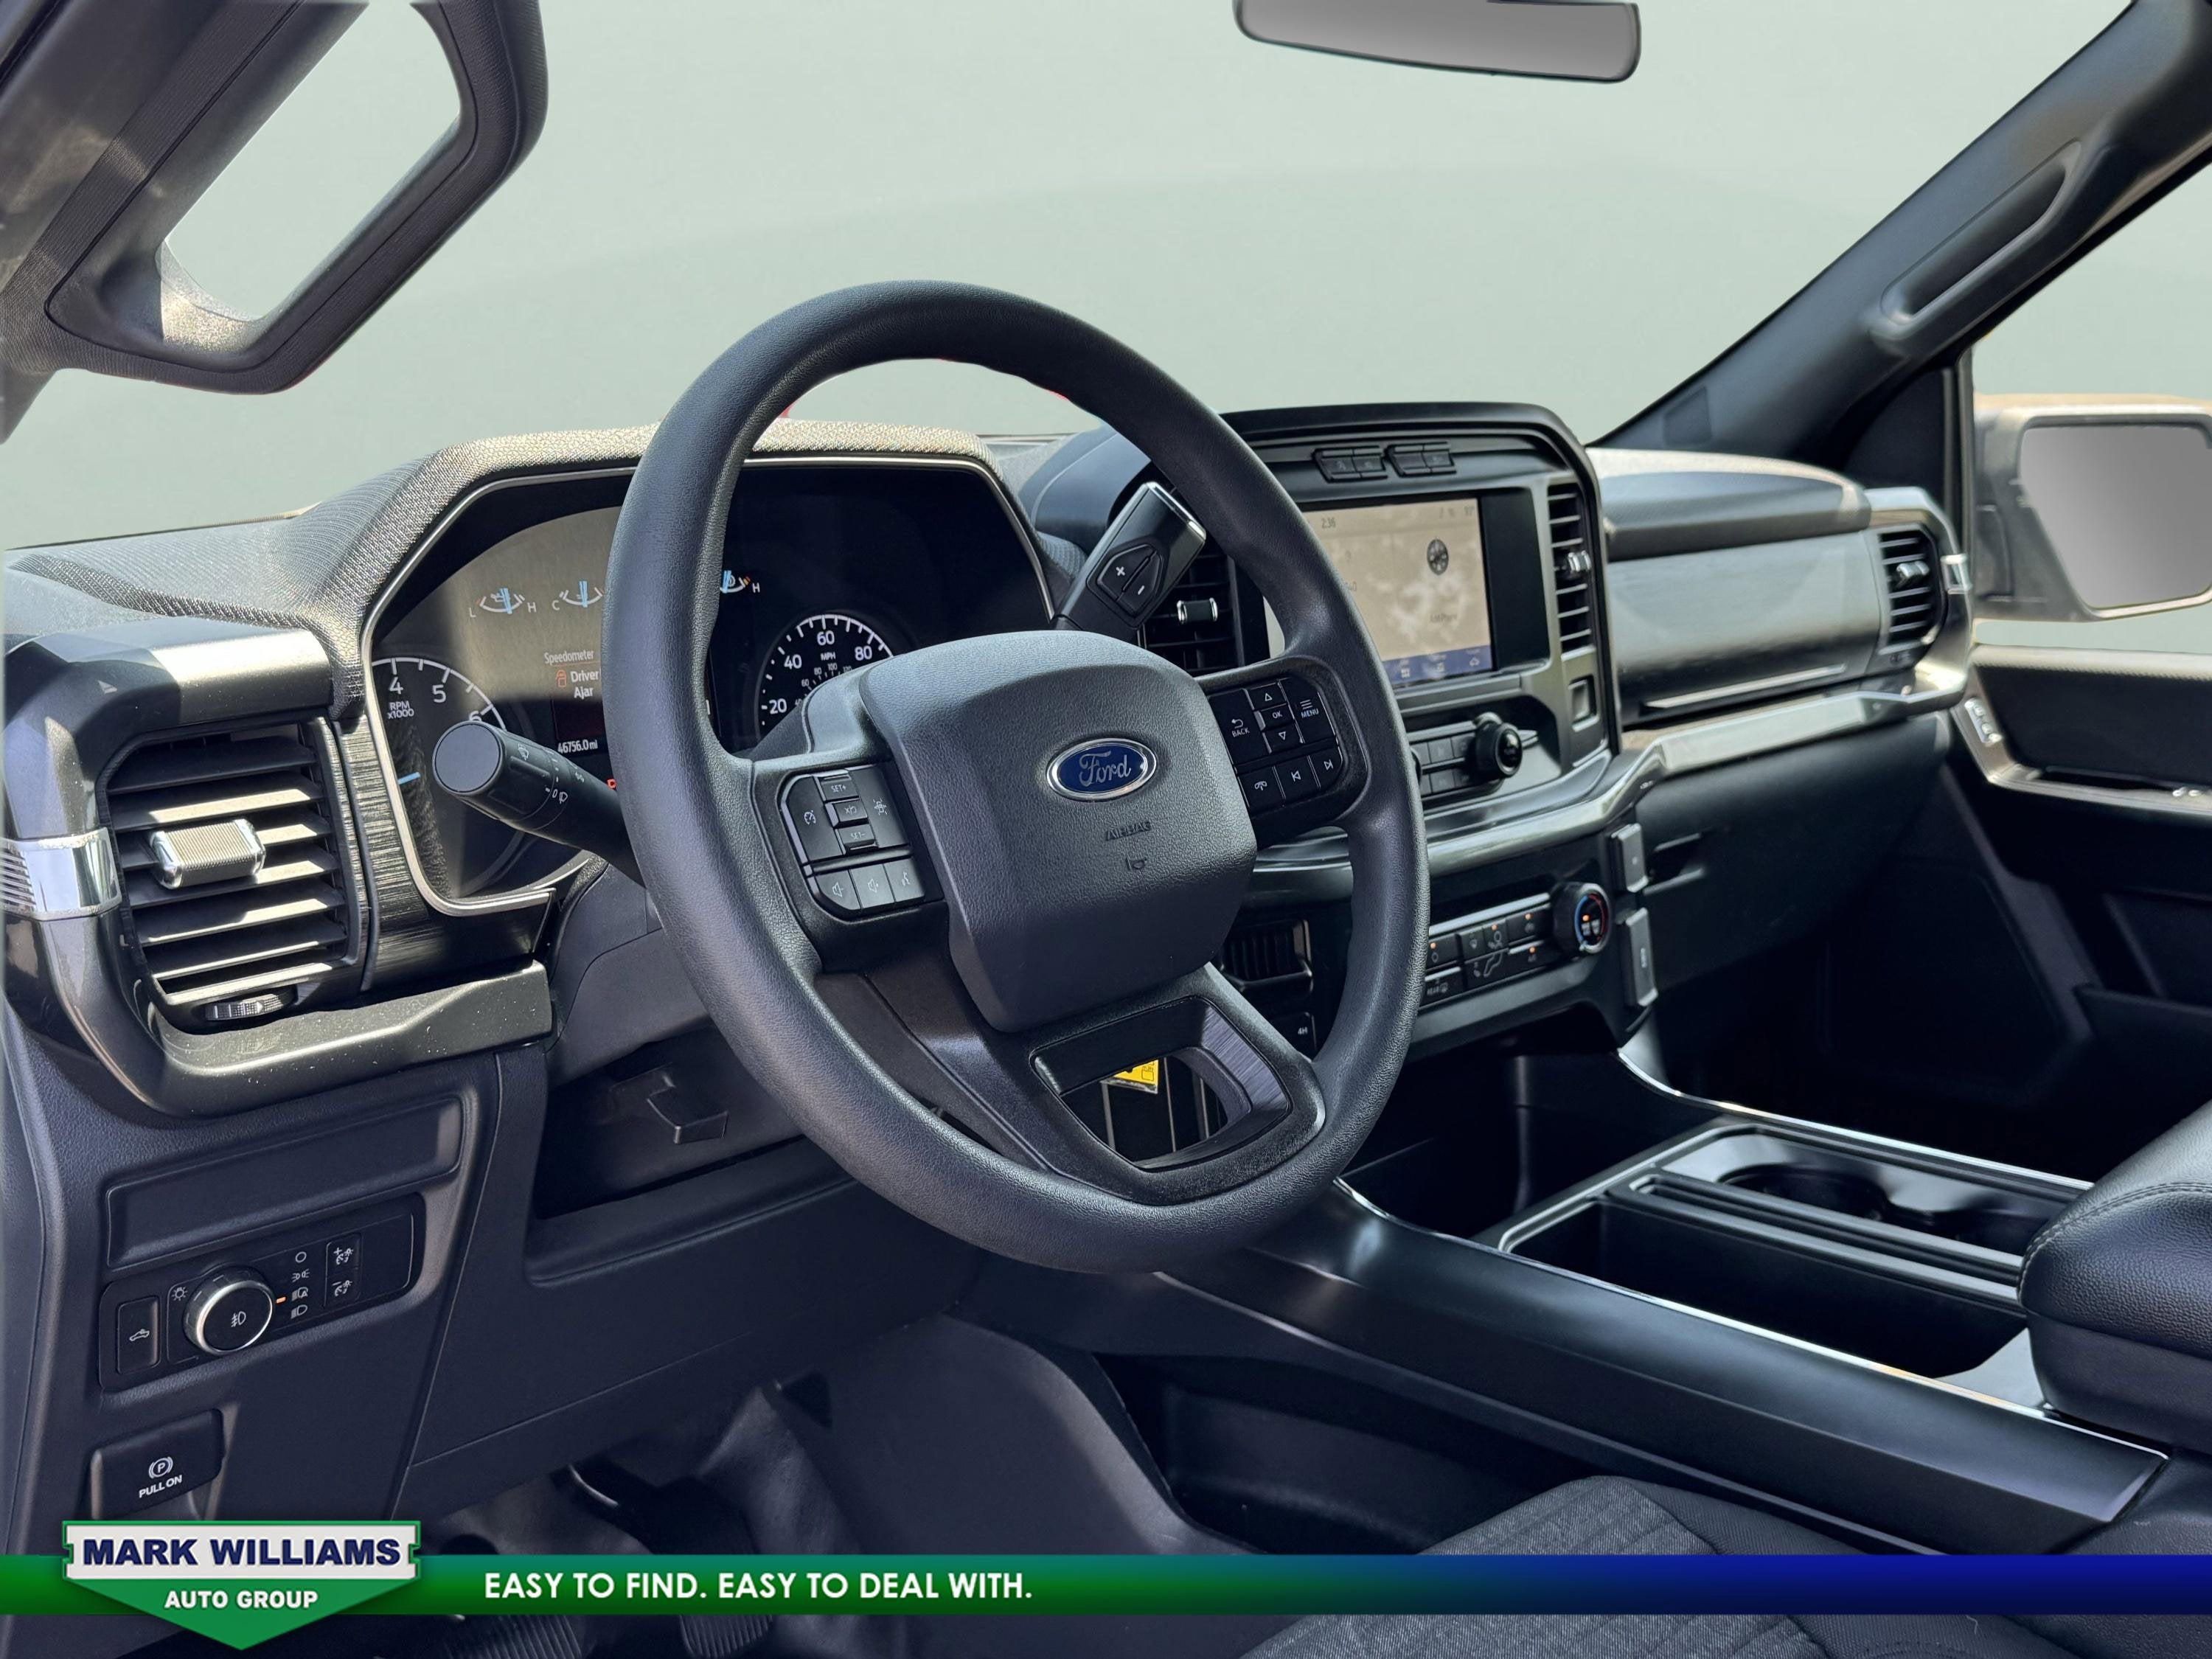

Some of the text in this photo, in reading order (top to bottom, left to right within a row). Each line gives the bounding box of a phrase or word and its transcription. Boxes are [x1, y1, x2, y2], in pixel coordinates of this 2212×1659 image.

[527, 602, 537, 613] H
[552, 599, 560, 611] C
[816, 630, 835, 646] 60
[544, 650, 594, 666] Speedometer
[820, 652, 836, 661] MPH
[854, 646, 873, 661] 80
[784, 654, 802, 669] 40
[570, 669, 599, 683] Driver
[389, 676, 404, 695] 4
[432, 684, 447, 703] 5
[574, 686, 594, 700] Ajar
[389, 700, 410, 711] RPM
[768, 698, 787, 714] 20
[386, 708, 414, 720] x1000
[1272, 710, 1282, 719] OK
[1301, 708, 1319, 719] MENU
[1231, 727, 1251, 738] BACK
[557, 740, 589, 754] 46756.0
[1079, 751, 1132, 787] Ford
[139, 1475, 182, 1498] PULL ON
